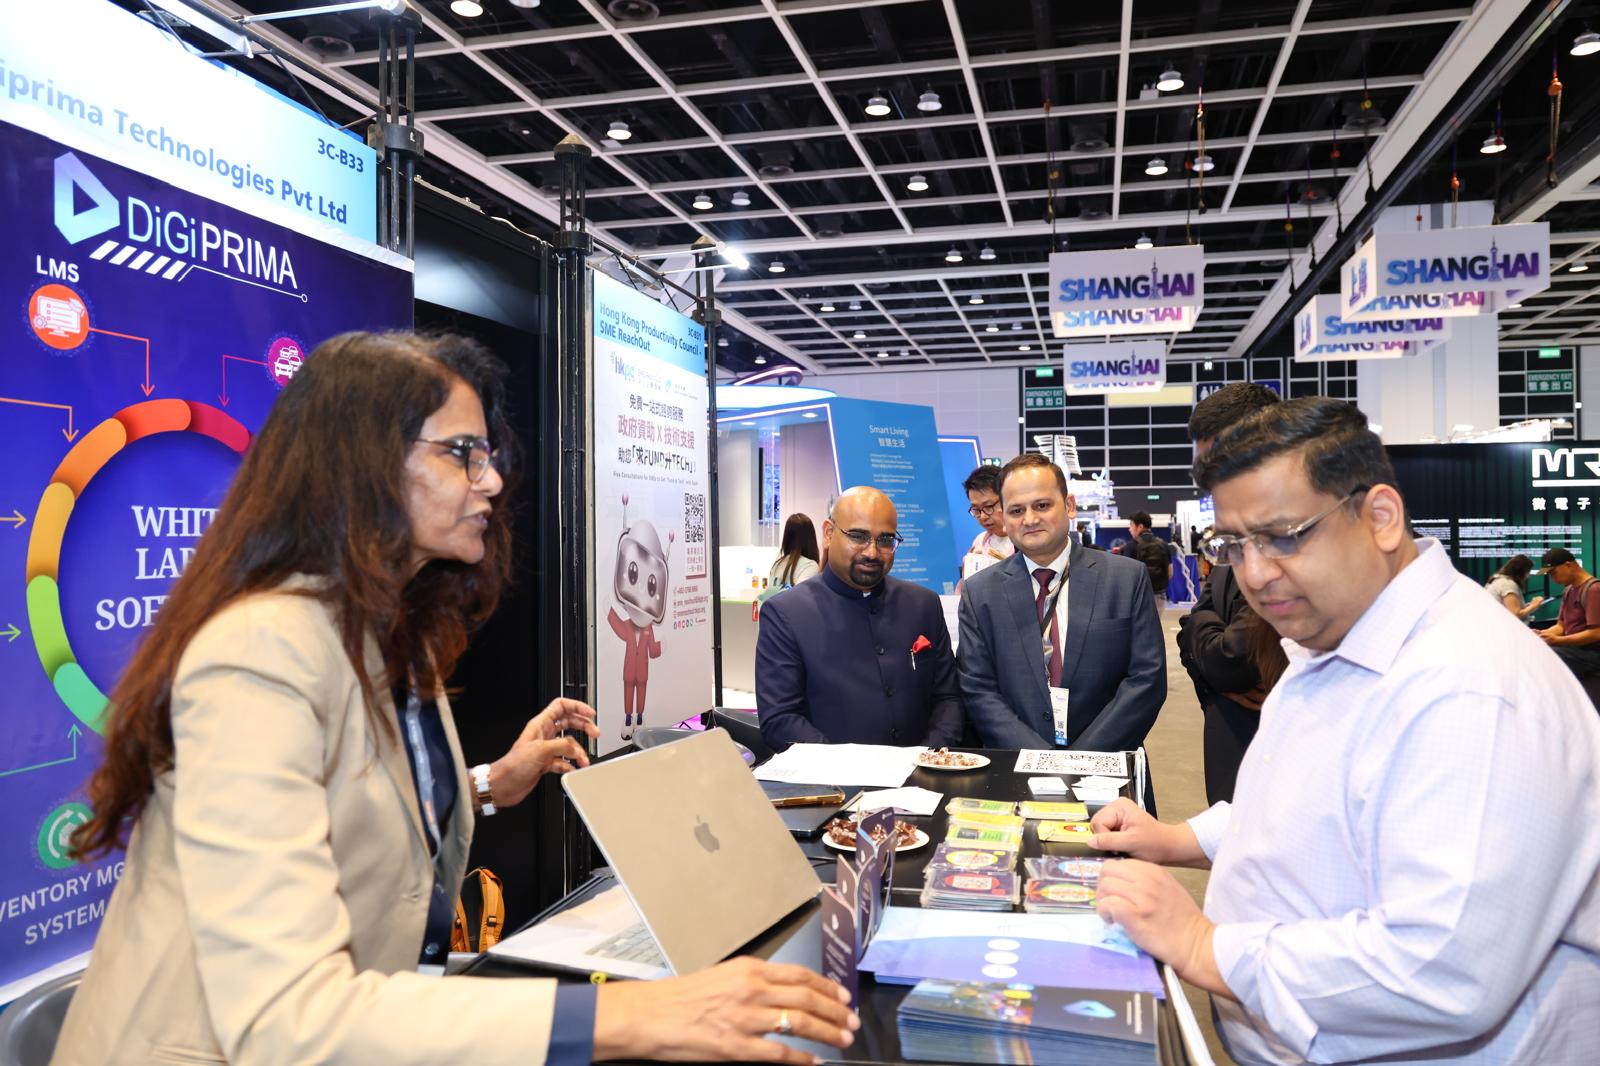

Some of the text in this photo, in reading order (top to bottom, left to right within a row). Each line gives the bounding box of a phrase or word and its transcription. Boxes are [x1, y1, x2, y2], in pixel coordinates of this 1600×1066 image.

[113, 108, 275, 195] Technologies
[281, 179, 313, 211] Pvt
[319, 195, 347, 224] Ltd
[317, 138, 364, 173] 3C-B33
[36, 255, 80, 283] LMS
[1058, 265, 1195, 302] SHANGHAI
[1386, 246, 1540, 286] SHANGHAI
[600, 302, 620, 325] Hong
[621, 311, 640, 333] Kong
[641, 320, 678, 349] Productivity
[679, 338, 699, 356] Council
[600, 320, 651, 352] SME ReachOut
[1070, 355, 1160, 378] SHANGHAI
[618, 415, 655, 443] 政府資助
[868, 424, 910, 438] Smart Living
[25, 899, 105, 945] SYSTEM
